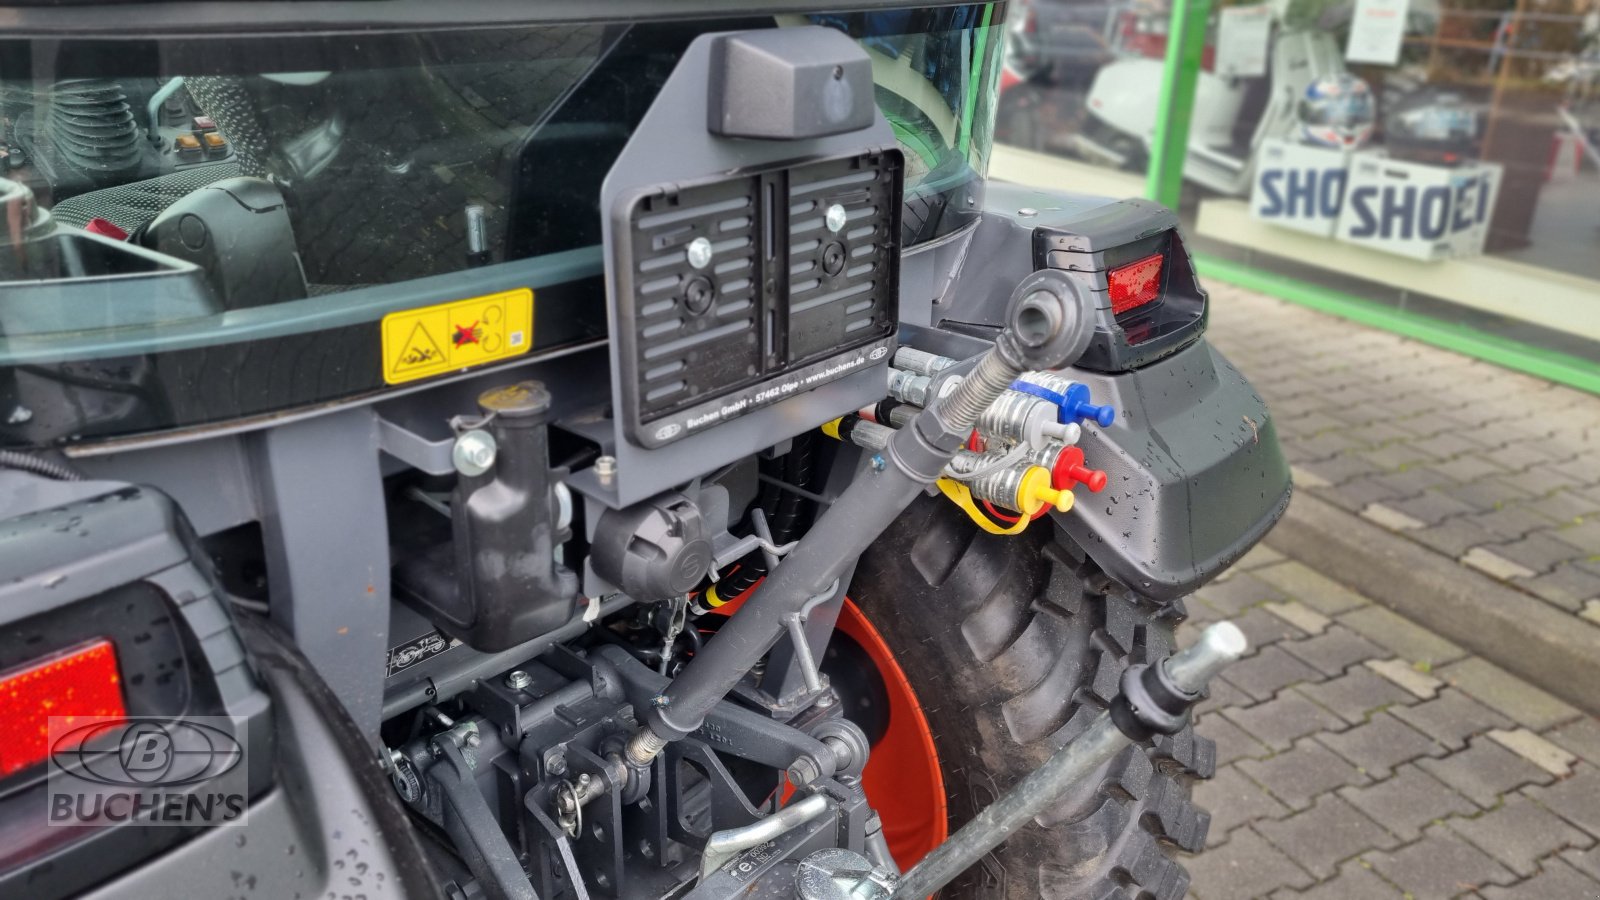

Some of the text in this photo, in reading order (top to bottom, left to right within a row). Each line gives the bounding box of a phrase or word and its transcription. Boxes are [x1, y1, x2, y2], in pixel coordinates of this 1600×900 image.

[687, 357, 865, 428] Buchen GmbH 57462 Olpe www.buchens.de
